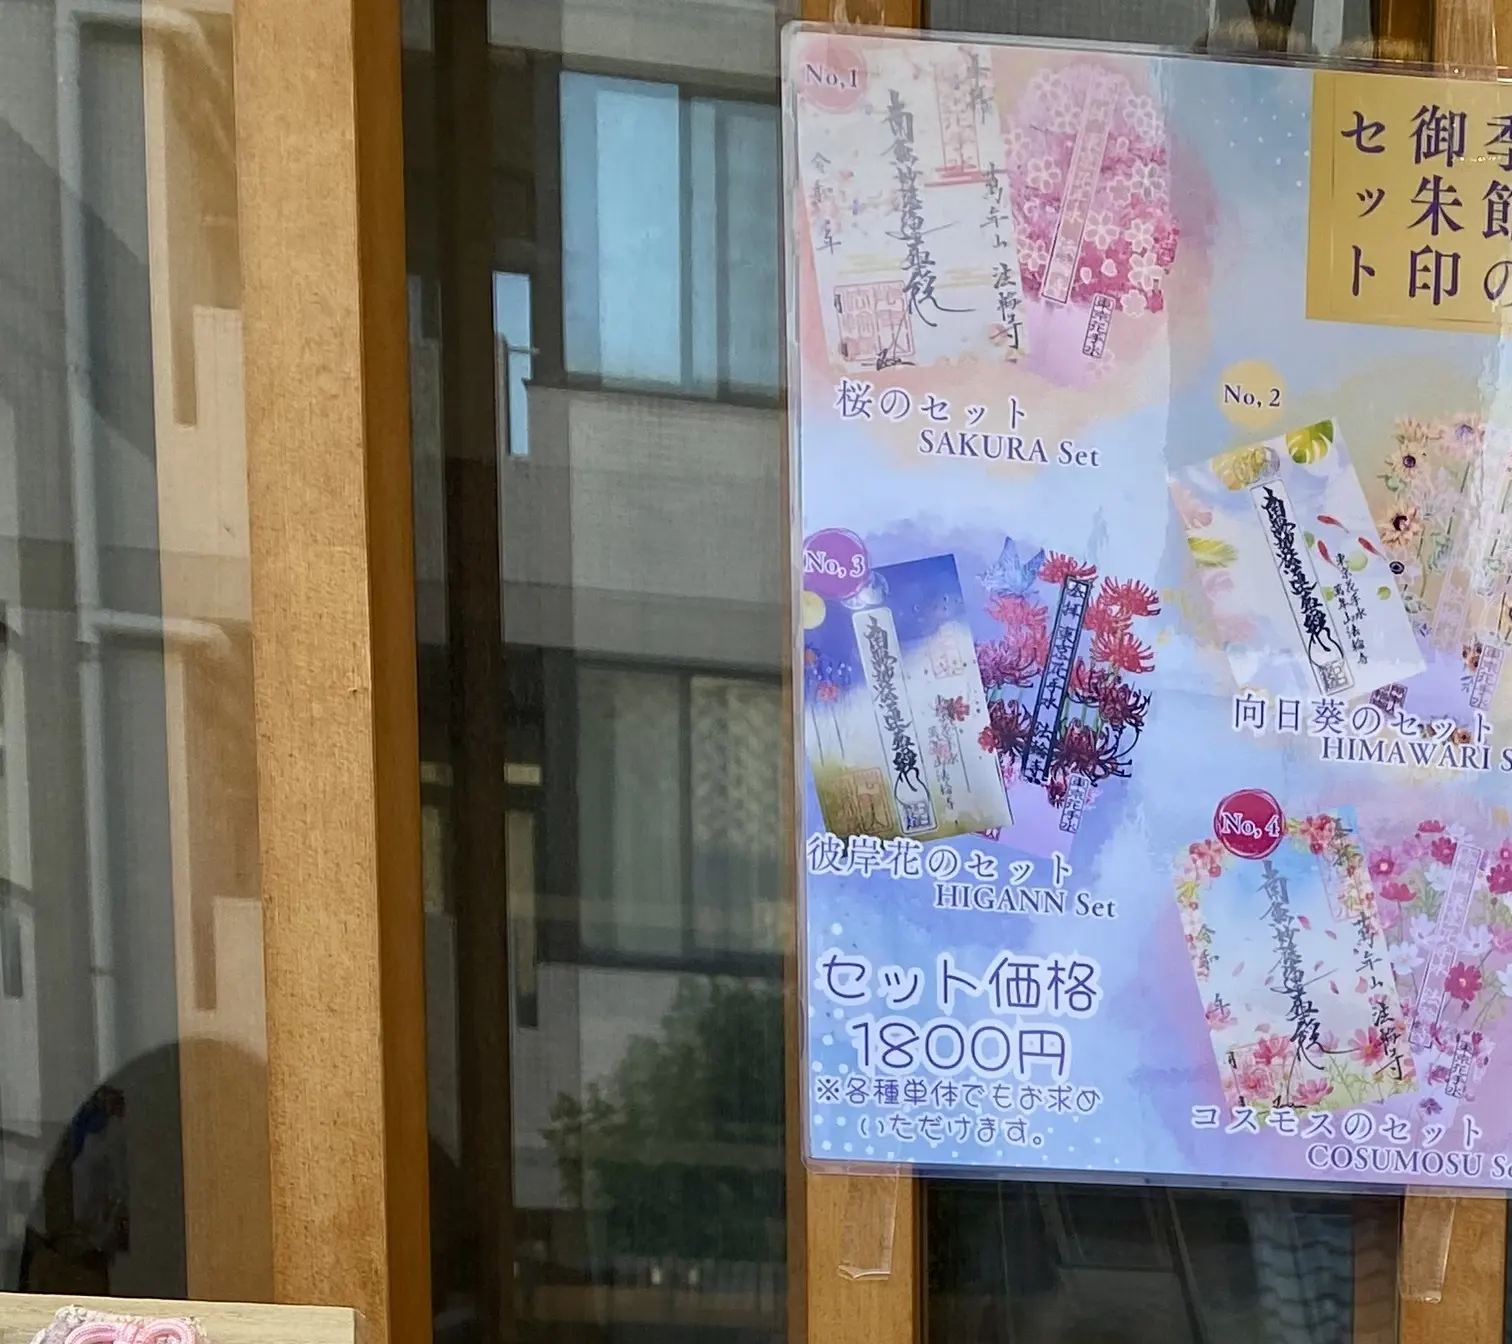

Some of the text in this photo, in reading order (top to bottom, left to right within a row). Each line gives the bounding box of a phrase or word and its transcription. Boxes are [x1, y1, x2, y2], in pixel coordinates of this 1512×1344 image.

[1341, 110, 1386, 297] セット
[1407, 104, 1467, 306] 御朱印
[837, 380, 1026, 429] 桜のセット
[919, 430, 1100, 467] SAKURA Set
[1235, 694, 1493, 745] 向日葵のセット
[1322, 735, 1491, 771] HIMAWARI
[807, 835, 1072, 886] 彼岸花のセット
[936, 884, 1117, 918] HIGANN Set
[824, 955, 1099, 1012] セット価格
[852, 1022, 1066, 1077] 1800円
[860, 1116, 1042, 1147] いただけます。
[1194, 1107, 1482, 1149] コスモスのセット
[1308, 1145, 1482, 1176] COSUMOSU
